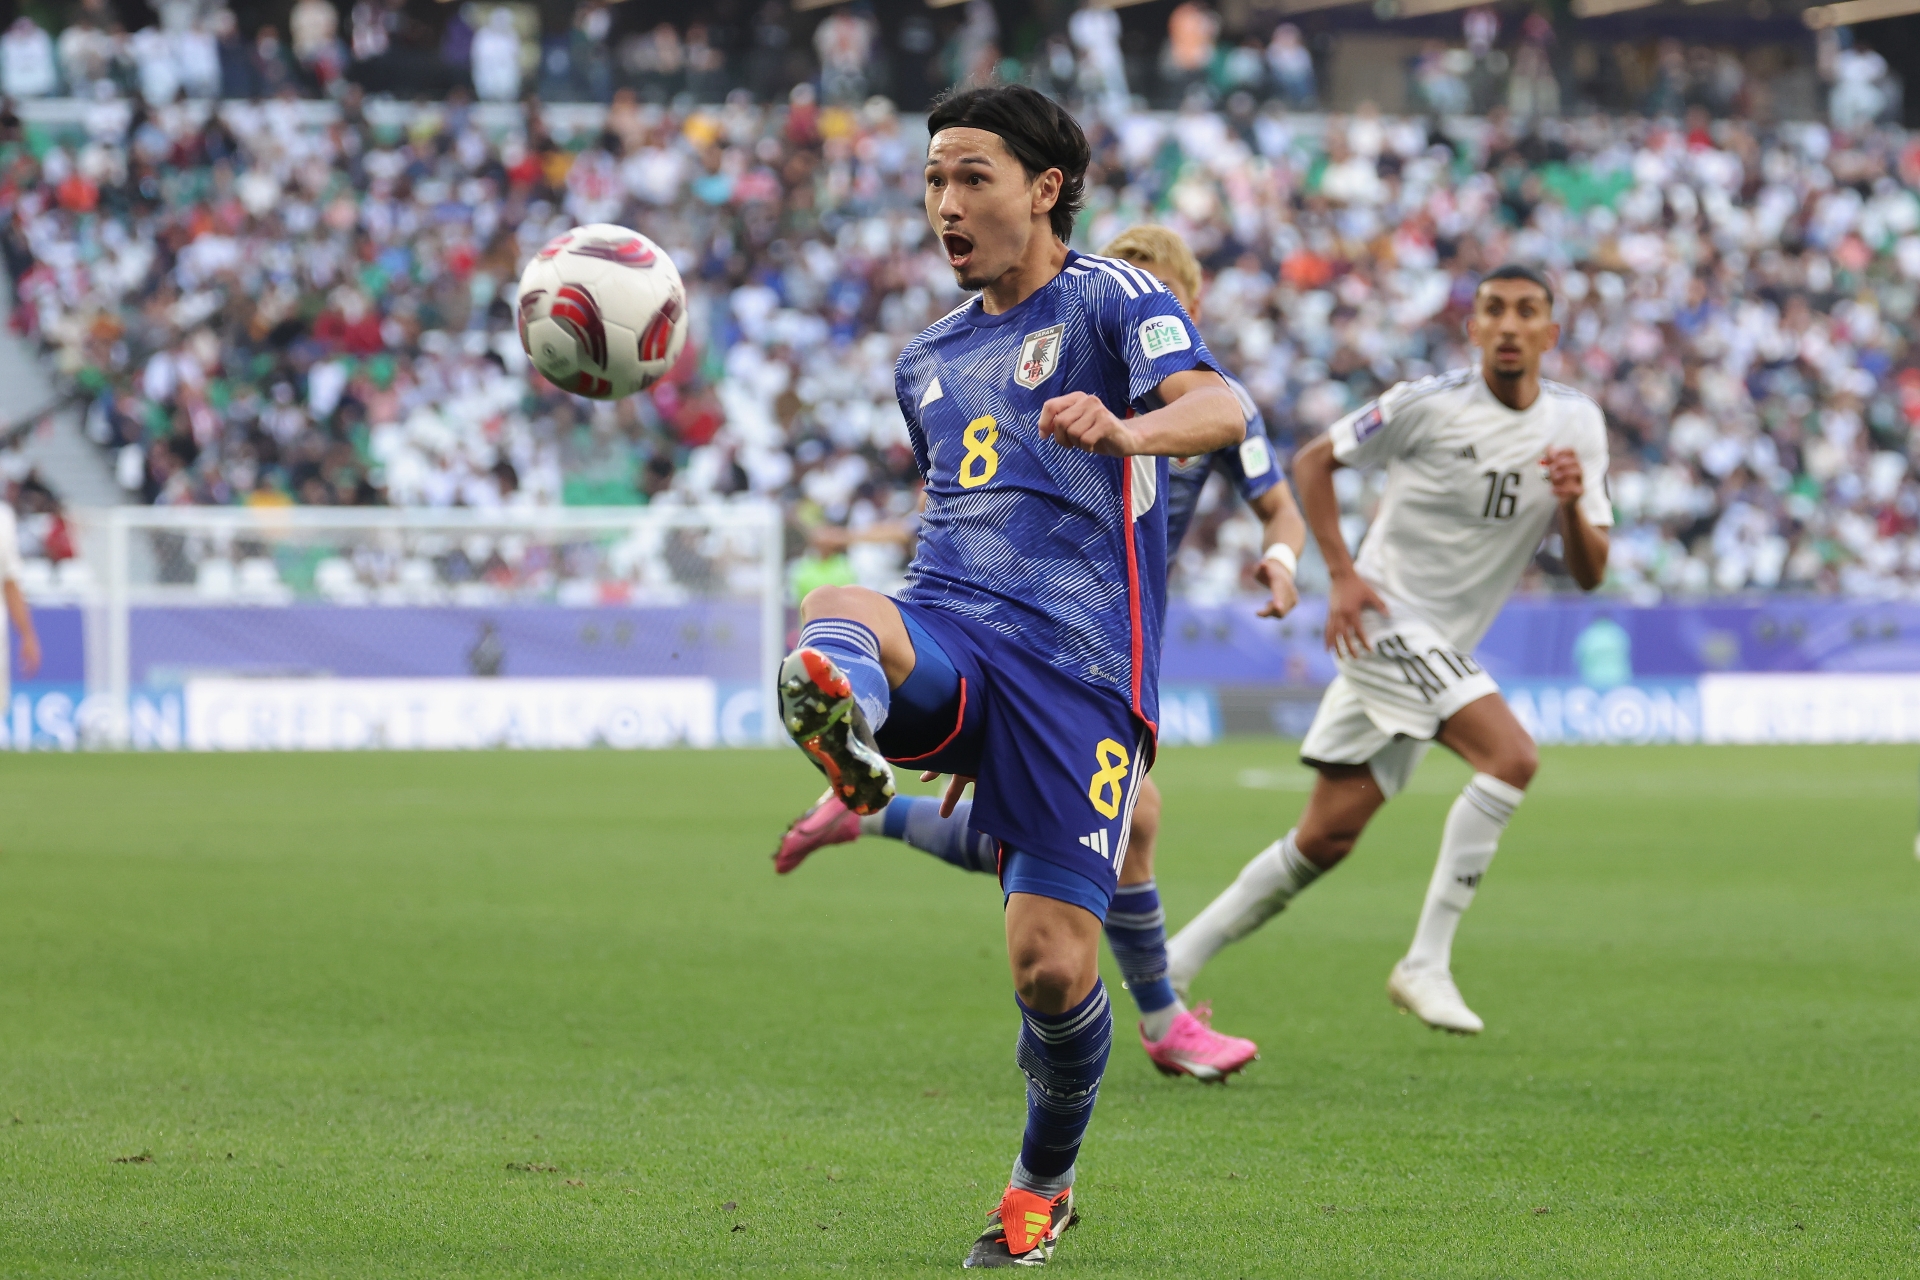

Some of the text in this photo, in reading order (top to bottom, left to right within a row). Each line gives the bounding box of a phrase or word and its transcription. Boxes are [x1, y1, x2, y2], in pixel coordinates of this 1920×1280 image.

[1033, 328, 1055, 339] JAPAN
[1145, 321, 1164, 333] AFC
[1146, 326, 1180, 343] LIVE
[1024, 366, 1044, 380] JFA
[958, 414, 999, 489] 8
[1480, 470, 1521, 519] 16
[0, 692, 182, 750] ISON
[1088, 738, 1130, 820] 8
